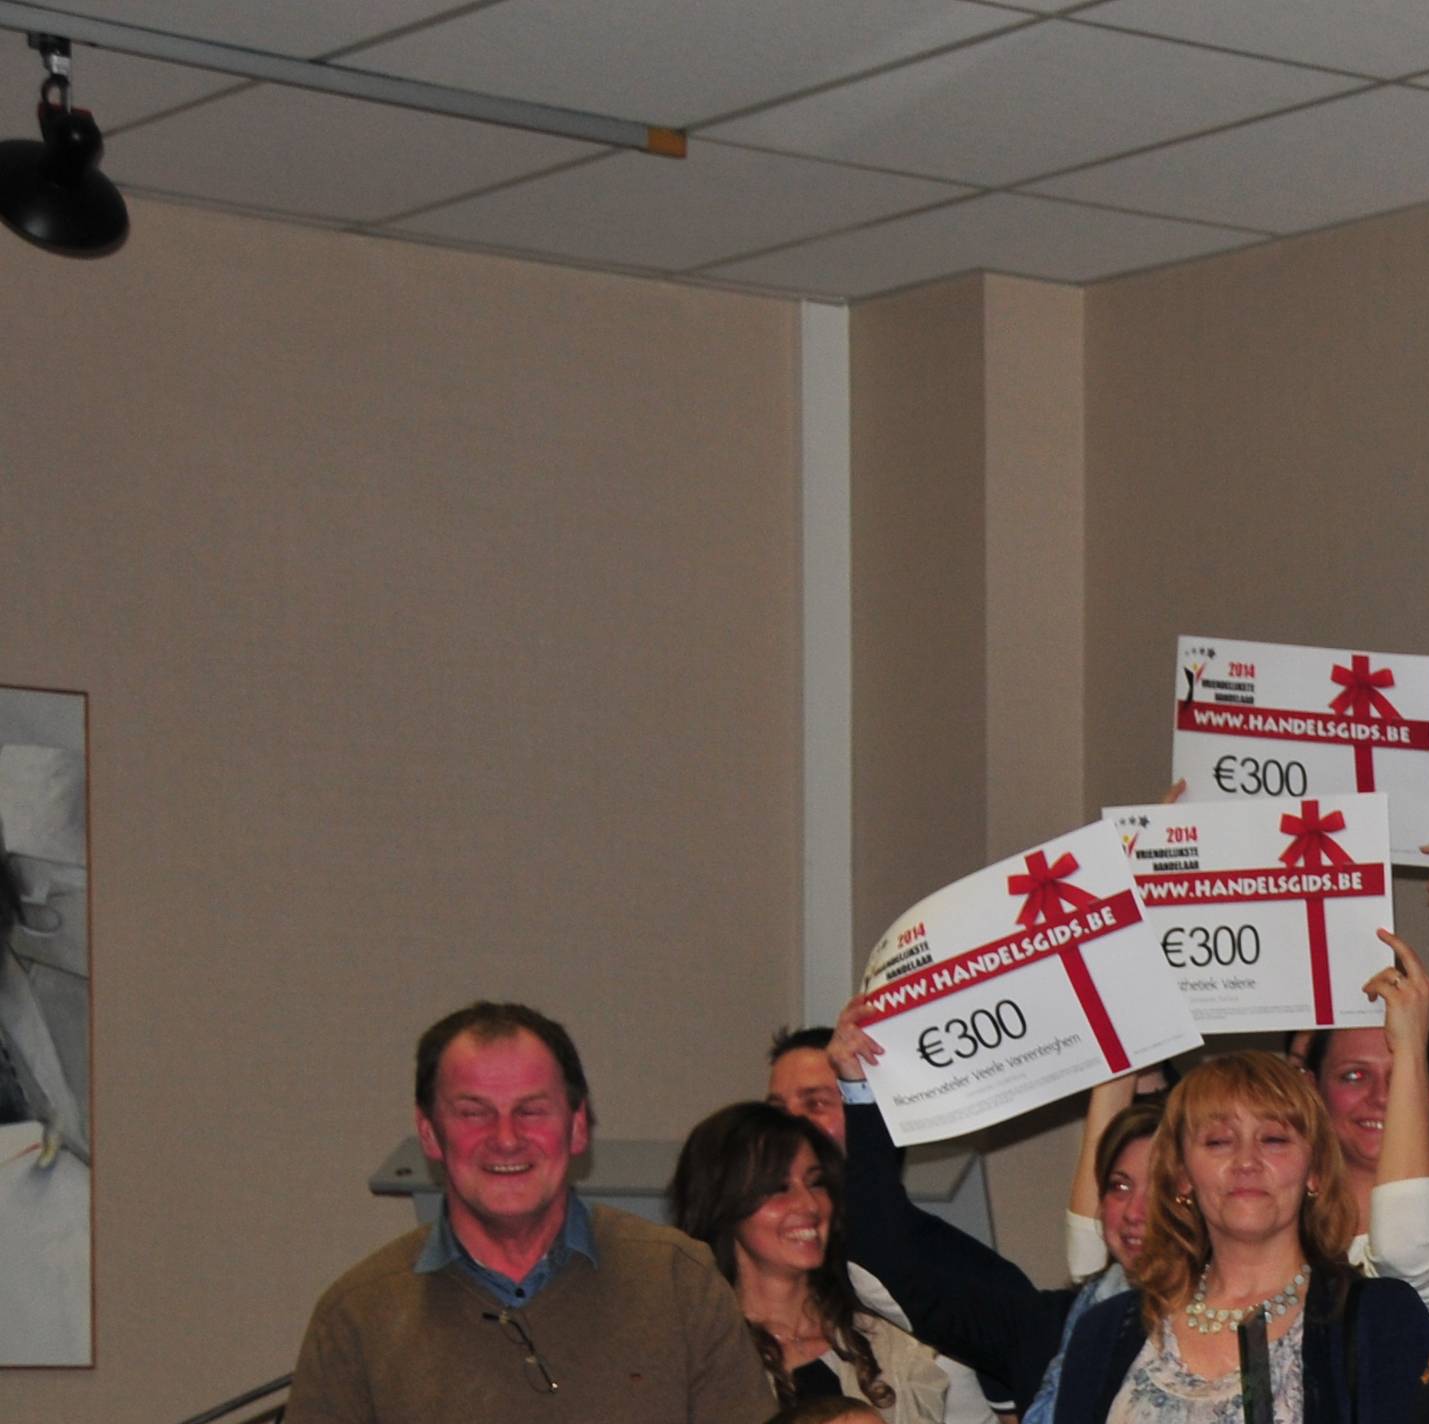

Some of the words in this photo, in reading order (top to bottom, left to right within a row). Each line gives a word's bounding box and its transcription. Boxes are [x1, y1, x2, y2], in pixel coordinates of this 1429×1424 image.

[1228, 662, 1256, 678] 2014
[1193, 709, 1411, 743] WWW.HANDELSGIDS.BE
[1213, 755, 1308, 797] €300
[1166, 826, 1198, 844] 2014
[1161, 924, 1260, 968] €300
[917, 999, 1028, 1068] €300
